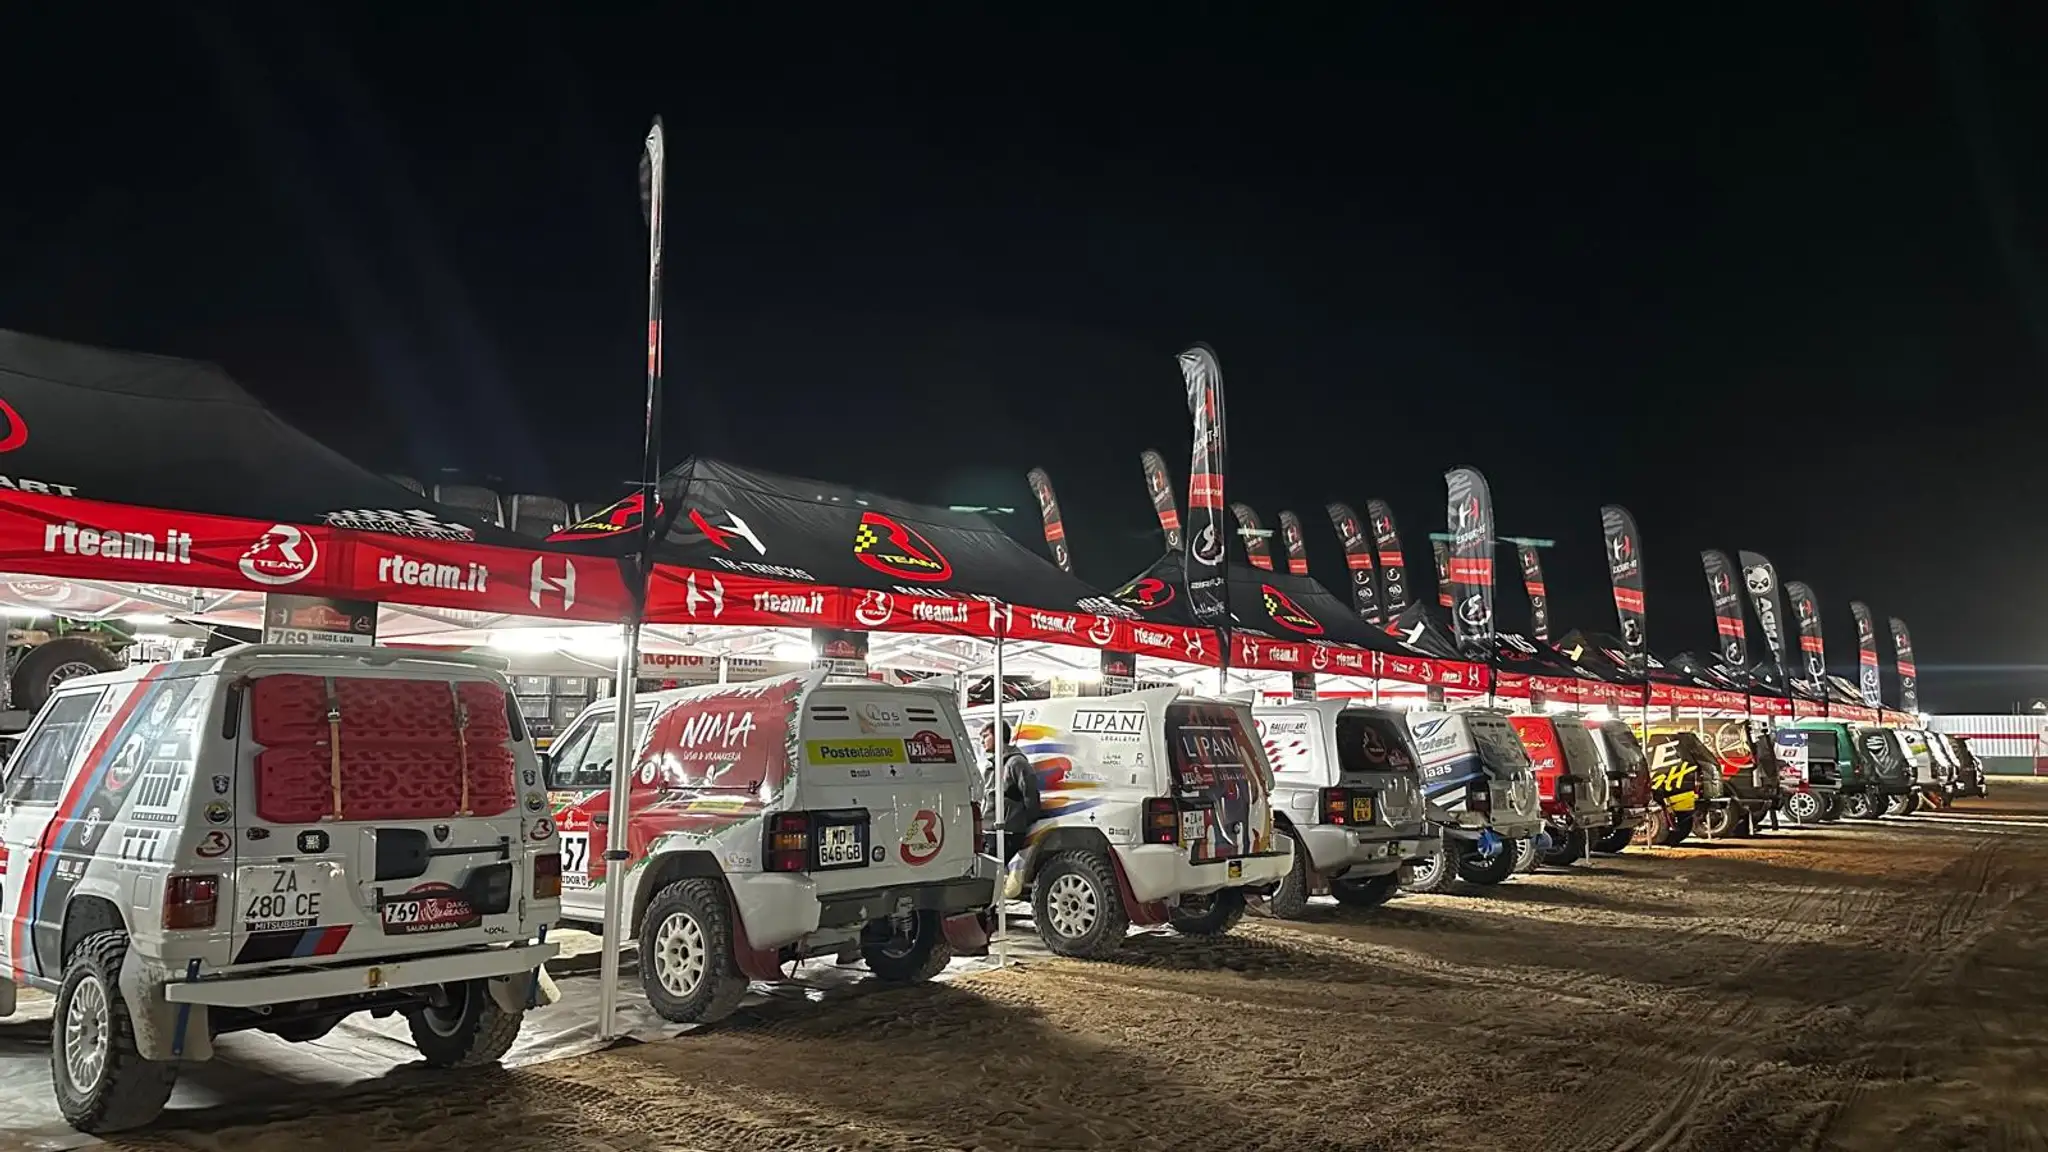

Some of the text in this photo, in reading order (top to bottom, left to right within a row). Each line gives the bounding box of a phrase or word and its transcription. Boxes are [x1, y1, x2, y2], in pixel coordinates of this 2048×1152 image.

[44, 523, 193, 564] rteam.it
[257, 559, 304, 570] TEAM
[877, 554, 942, 570] TEAM
[378, 555, 488, 593] rteam.it
[754, 591, 825, 615] rteam.it
[912, 600, 969, 623] rteam.it
[1031, 611, 1077, 634] rteam.it
[680, 711, 757, 748] NIMA
[1072, 713, 1144, 731] LIPANI
[1182, 736, 1242, 757] LIPANI
[560, 837, 588, 872] 57
[273, 870, 298, 893] ZA
[246, 892, 322, 918] 480 CE
[387, 902, 418, 922] 769
[254, 920, 310, 931] MITSUBISHI
[405, 921, 459, 933] SAUDI ARABIA
